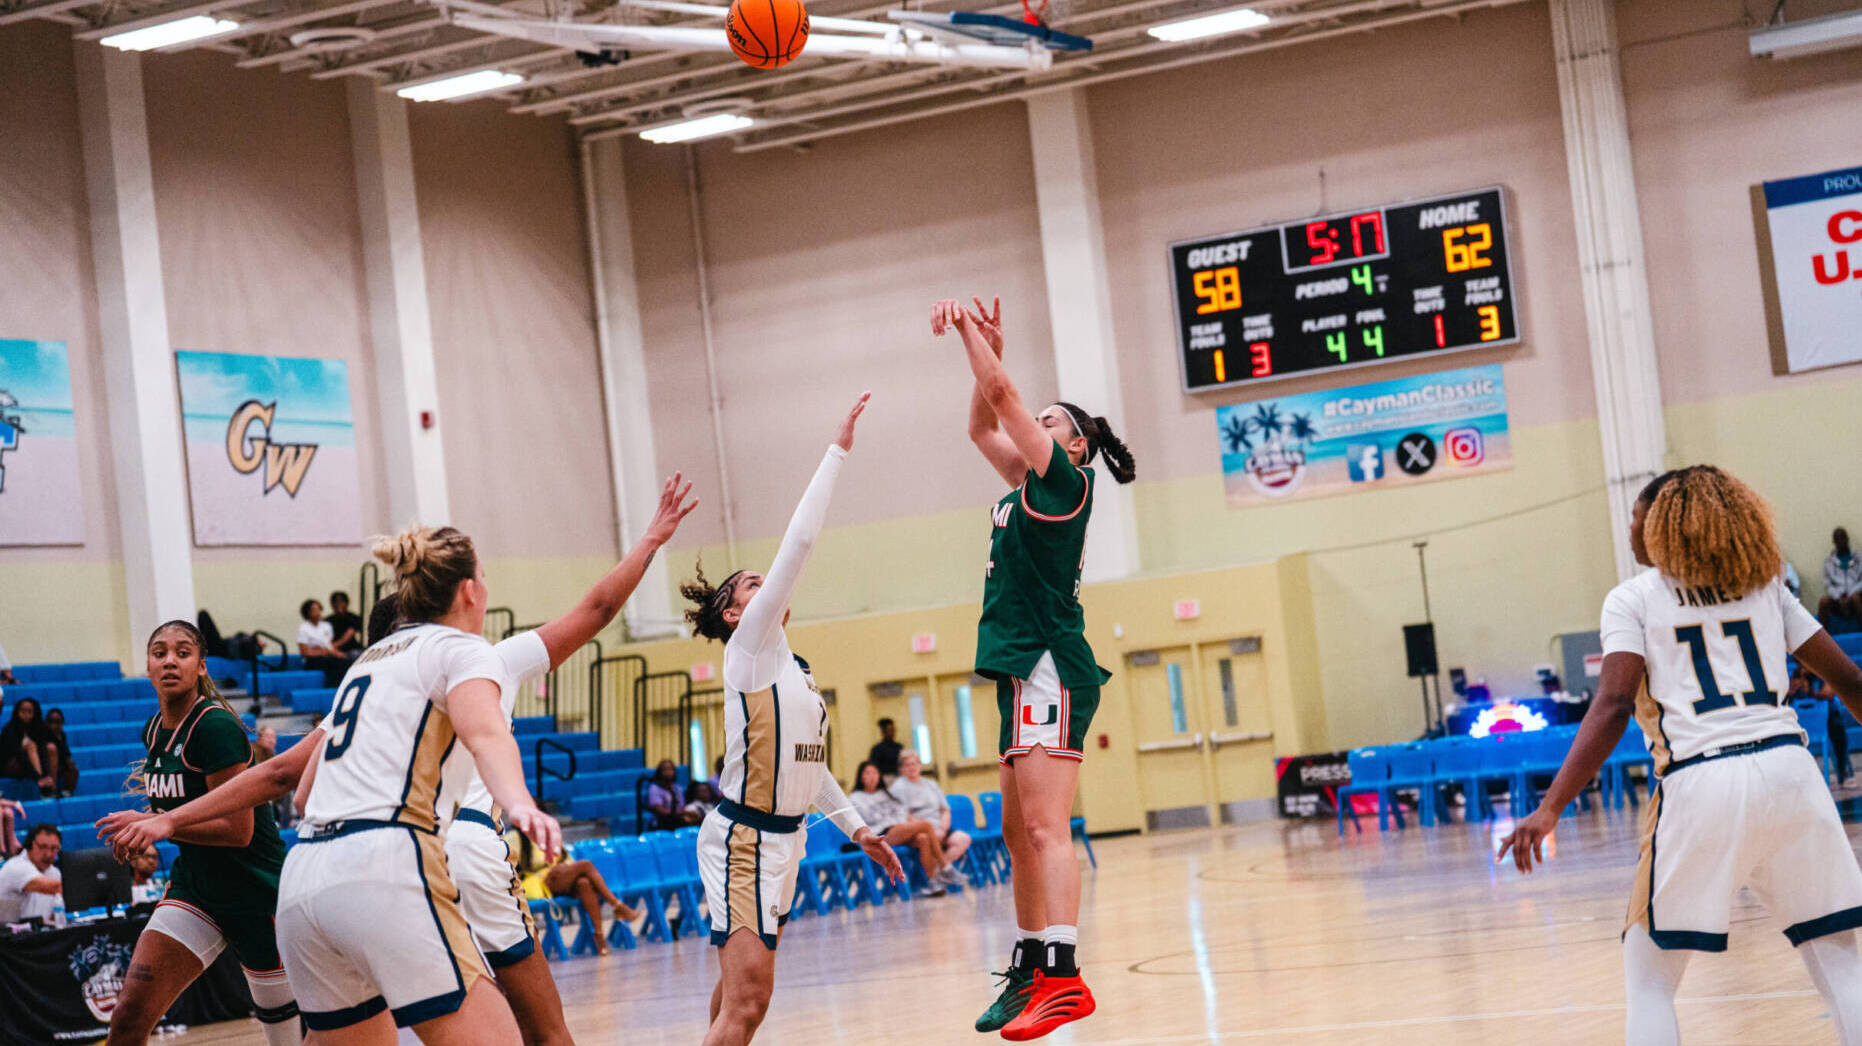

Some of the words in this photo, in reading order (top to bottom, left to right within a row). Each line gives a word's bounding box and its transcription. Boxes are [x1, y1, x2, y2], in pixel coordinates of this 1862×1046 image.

[1418, 201, 1480, 230] HOME
[1305, 210, 1386, 266] 5:17
[1442, 223, 1493, 273] 62
[1187, 240, 1252, 269] GUEST
[1193, 266, 1242, 315] 58
[1295, 277, 1349, 300] PERIOD
[1351, 264, 1374, 296] 4
[1413, 285, 1443, 301] TIME
[1464, 276, 1500, 292] TEAM
[1465, 288, 1503, 306] FOULS
[1355, 308, 1386, 325] FOUL
[1414, 297, 1446, 314] OUTS
[1190, 322, 1222, 337] TEAM
[1243, 313, 1272, 329] TIME
[1243, 325, 1275, 341] OUTS
[1302, 313, 1348, 333] PLAYER
[1433, 313, 1446, 348] 1
[1477, 305, 1501, 341] 3
[1189, 333, 1226, 350] FOULS
[1326, 330, 1348, 363] 4
[1362, 325, 1385, 357] 4
[1213, 349, 1226, 383] 1
[1249, 342, 1272, 378] 3
[1322, 379, 1494, 418] #CaymanClassic
[226, 399, 318, 499] GW
[1673, 617, 1778, 715] 11
[325, 673, 372, 762] 9
[1022, 704, 1058, 726] U
[143, 773, 185, 798] IAMI
